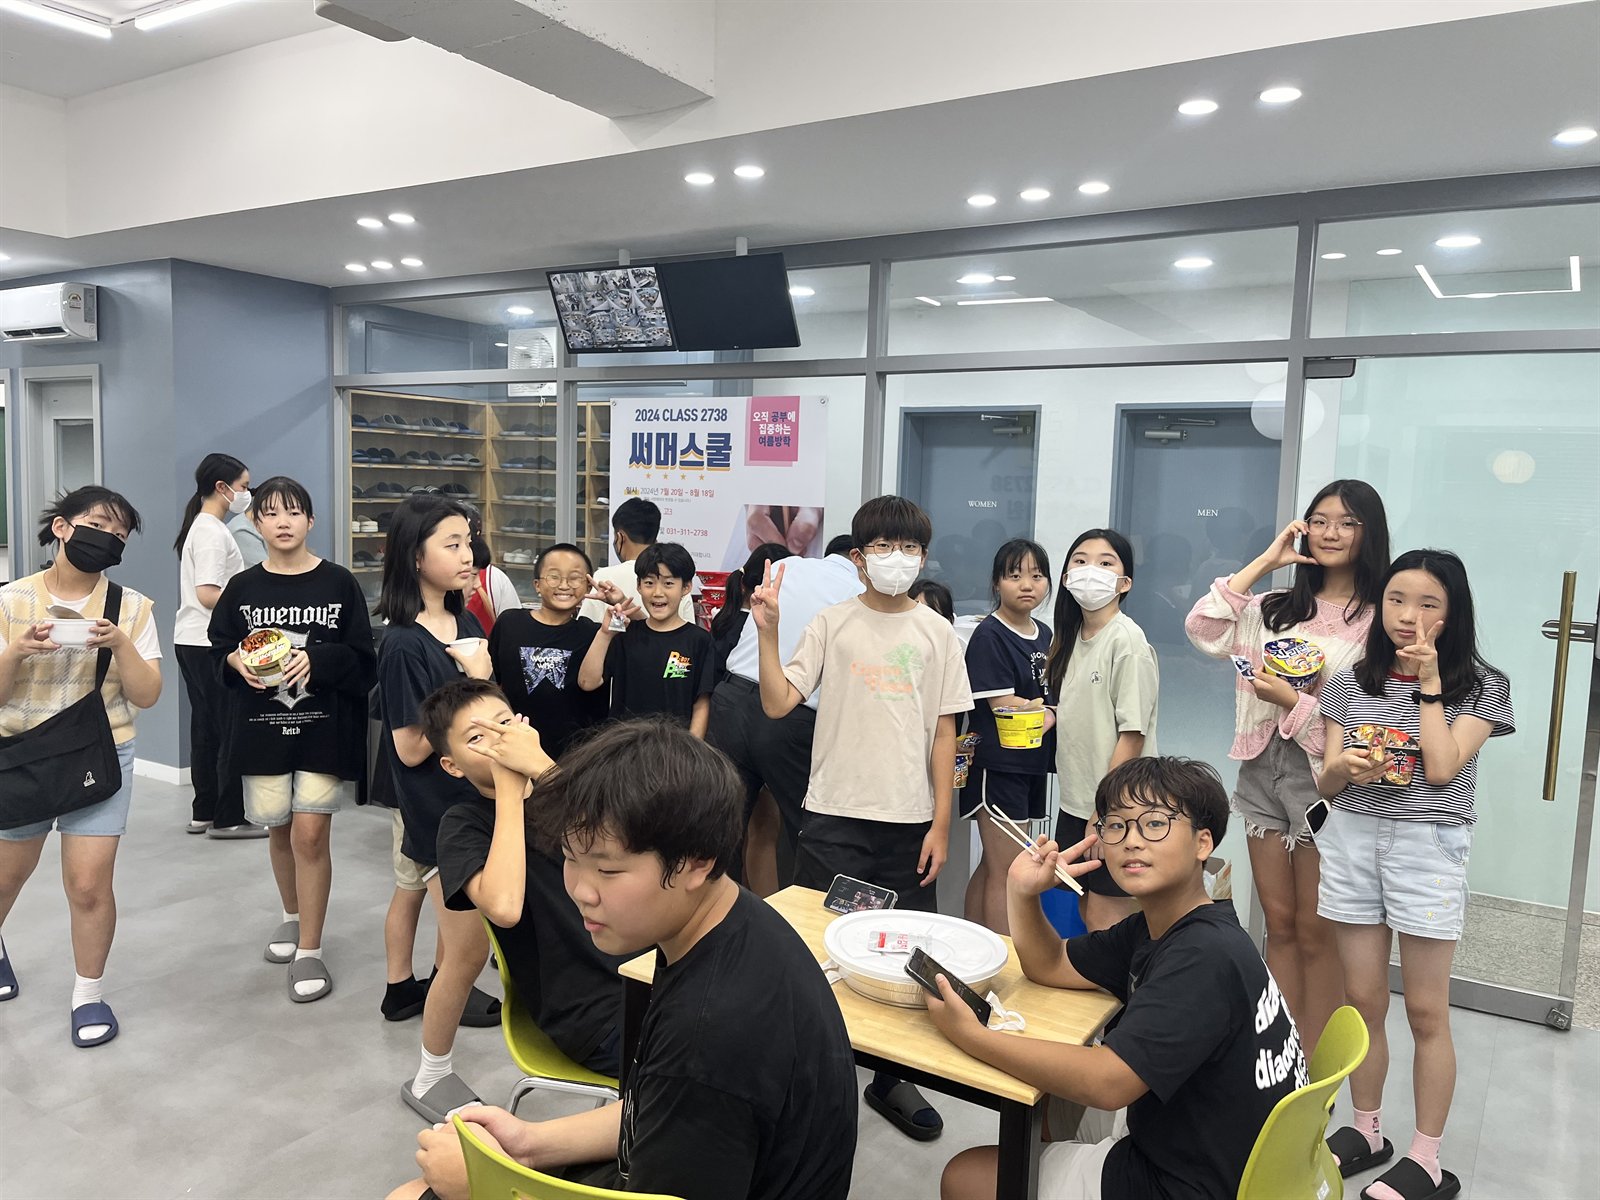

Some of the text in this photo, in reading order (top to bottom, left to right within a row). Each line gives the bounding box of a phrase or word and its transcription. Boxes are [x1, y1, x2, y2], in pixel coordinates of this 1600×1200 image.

[635, 408, 728, 422] 2024 CLASS 2738
[752, 411, 796, 423] 오직 공부에
[758, 423, 792, 435] 집중하는
[758, 436, 791, 447] 여름방학
[629, 432, 732, 471] 써머스쿨
[640, 488, 659, 496] 2024년
[671, 488, 683, 496] 20일
[701, 490, 714, 498] 18일
[968, 500, 997, 508] WOMEN
[1197, 509, 1218, 517] MEN
[666, 527, 708, 536] 031-311-2738
